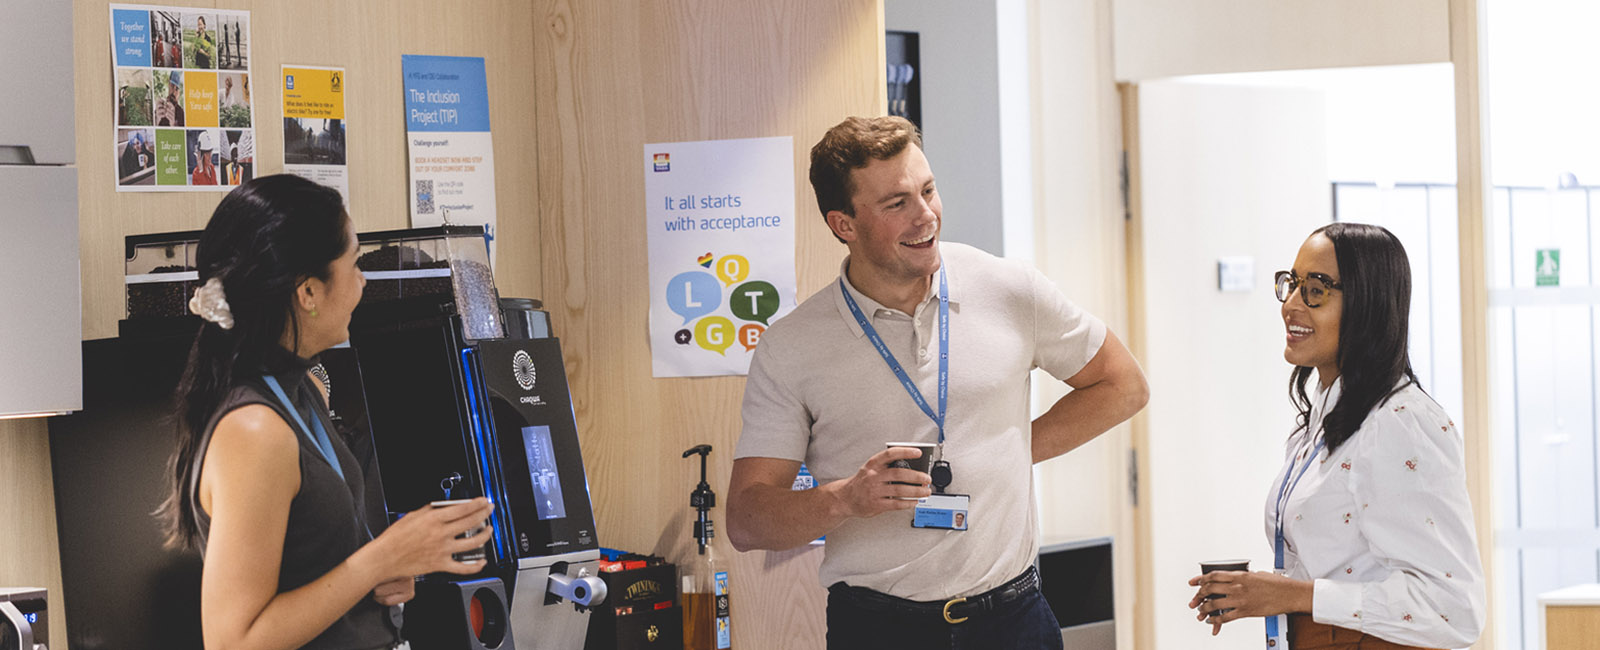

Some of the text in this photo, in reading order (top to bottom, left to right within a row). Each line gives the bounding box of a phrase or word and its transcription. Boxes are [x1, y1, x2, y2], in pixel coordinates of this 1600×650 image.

[120, 22, 144, 34] Together
[130, 36, 145, 44] stand
[410, 89, 460, 104] The Inclusion
[411, 109, 458, 126] Project (TIP)
[160, 140, 170, 150] Take
[163, 154, 179, 162] of each
[664, 194, 741, 210] It all starts
[664, 215, 781, 232] with acceptance
[724, 259, 740, 281] Q
[685, 281, 702, 308] L
[744, 291, 763, 315] T
[706, 323, 723, 345] G
[747, 328, 760, 345] B
[627, 580, 660, 598] TWININGS
